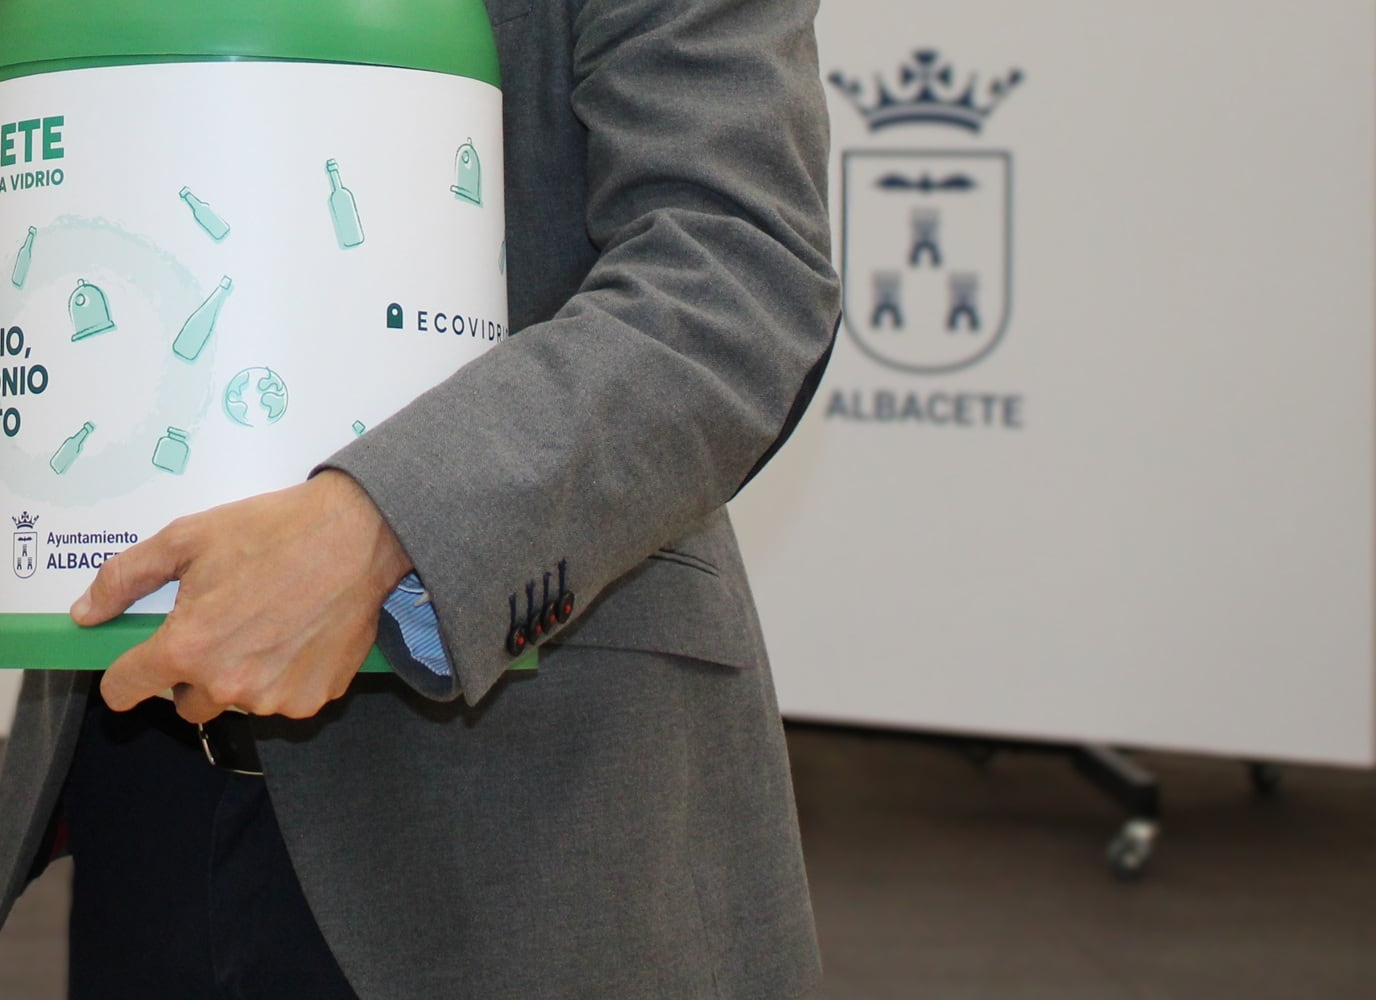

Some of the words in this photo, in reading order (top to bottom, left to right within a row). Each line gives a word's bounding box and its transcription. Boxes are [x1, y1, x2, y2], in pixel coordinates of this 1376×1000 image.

[10, 168, 65, 191] VIDRIO
[827, 387, 1025, 428] ALBACETE
[46, 530, 138, 548] Ayuntamiento
